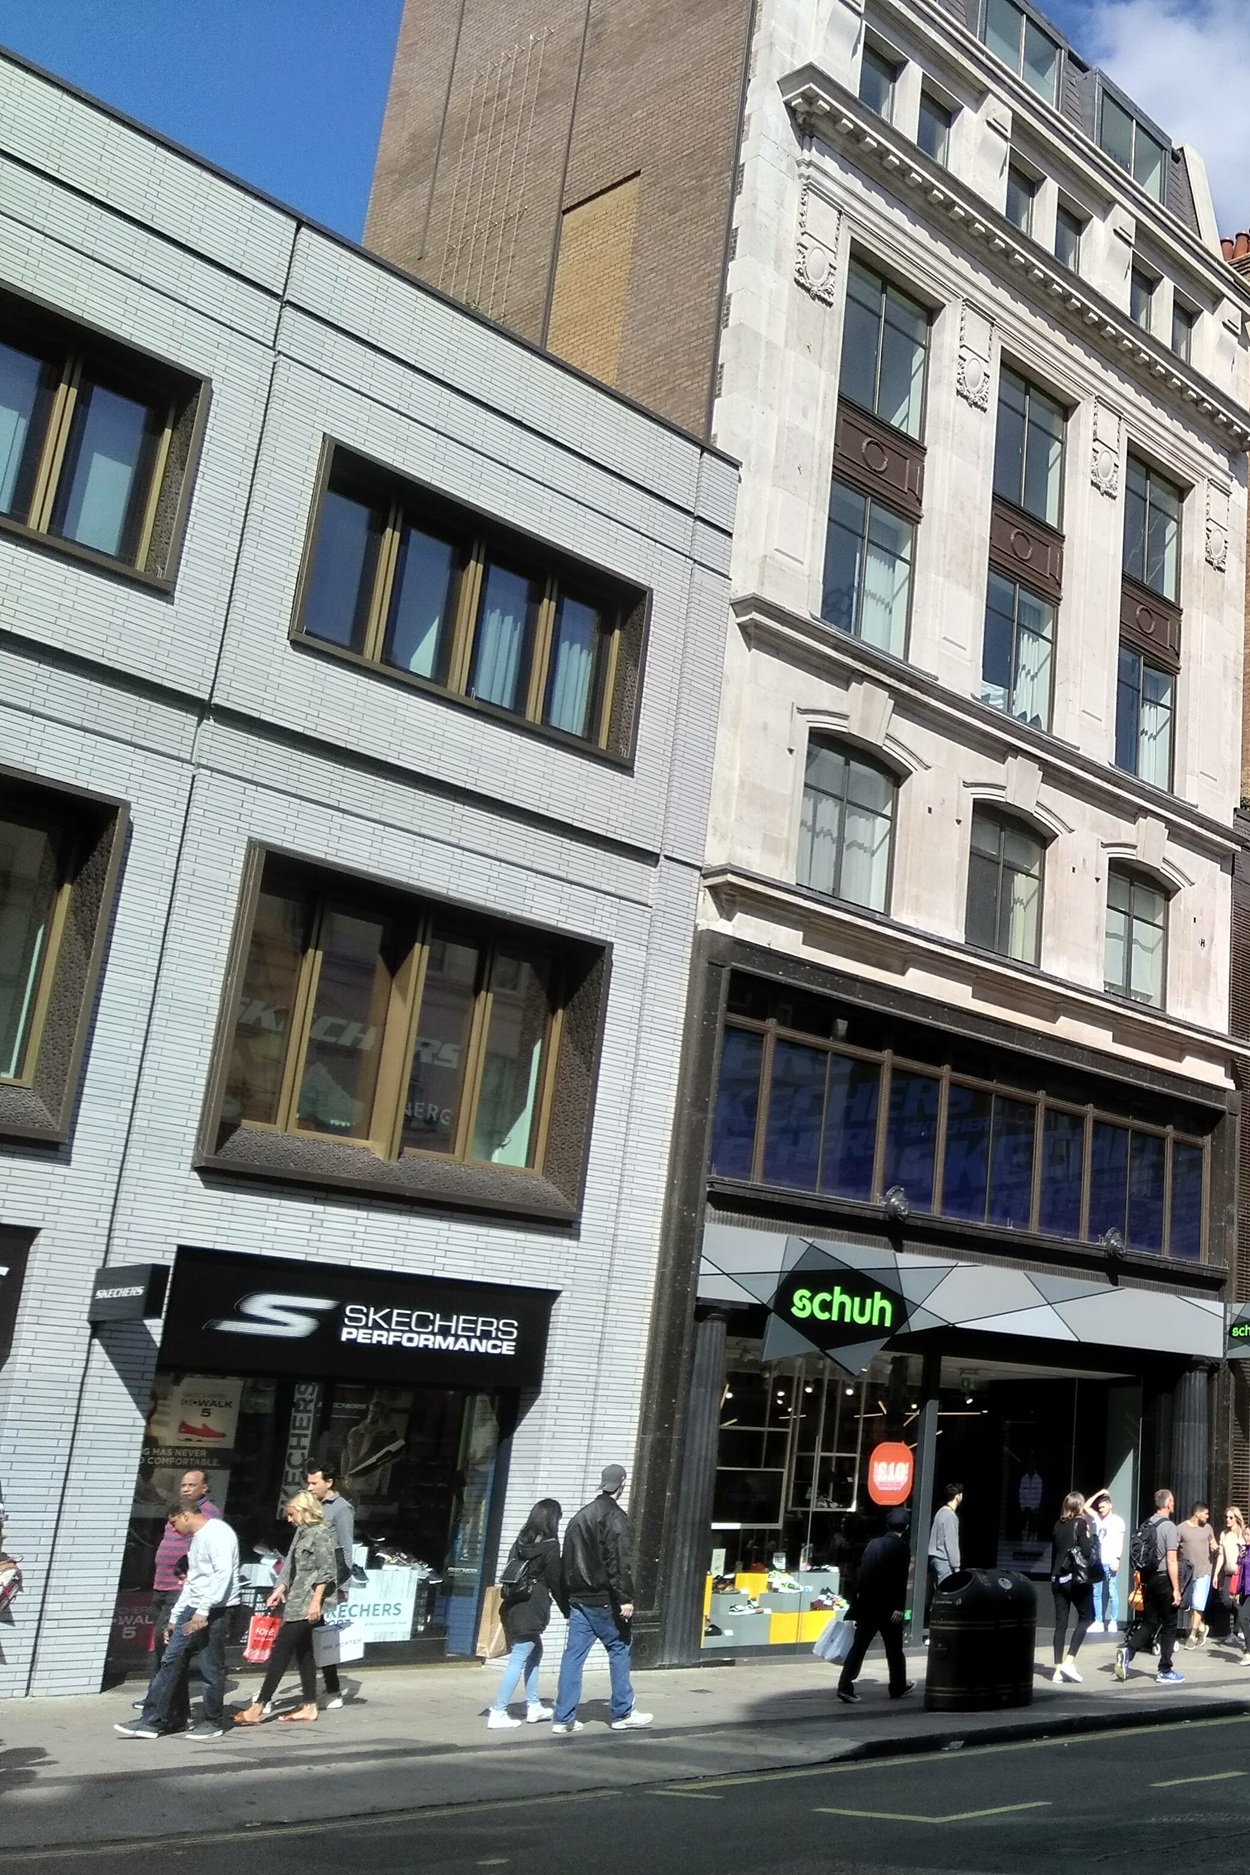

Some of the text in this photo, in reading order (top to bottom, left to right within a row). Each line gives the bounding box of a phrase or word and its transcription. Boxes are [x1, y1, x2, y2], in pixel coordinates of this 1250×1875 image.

[95, 1285, 145, 1300] SKECHERS
[790, 1286, 893, 1327] schuh
[343, 1304, 519, 1340] SKECHERS
[340, 1327, 517, 1355] PERFORMANCE
[200, 1407, 212, 1418] 5
[152, 1448, 172, 1456] HAS
[174, 1449, 207, 1458] NEVER
[121, 1626, 137, 1639] 5
